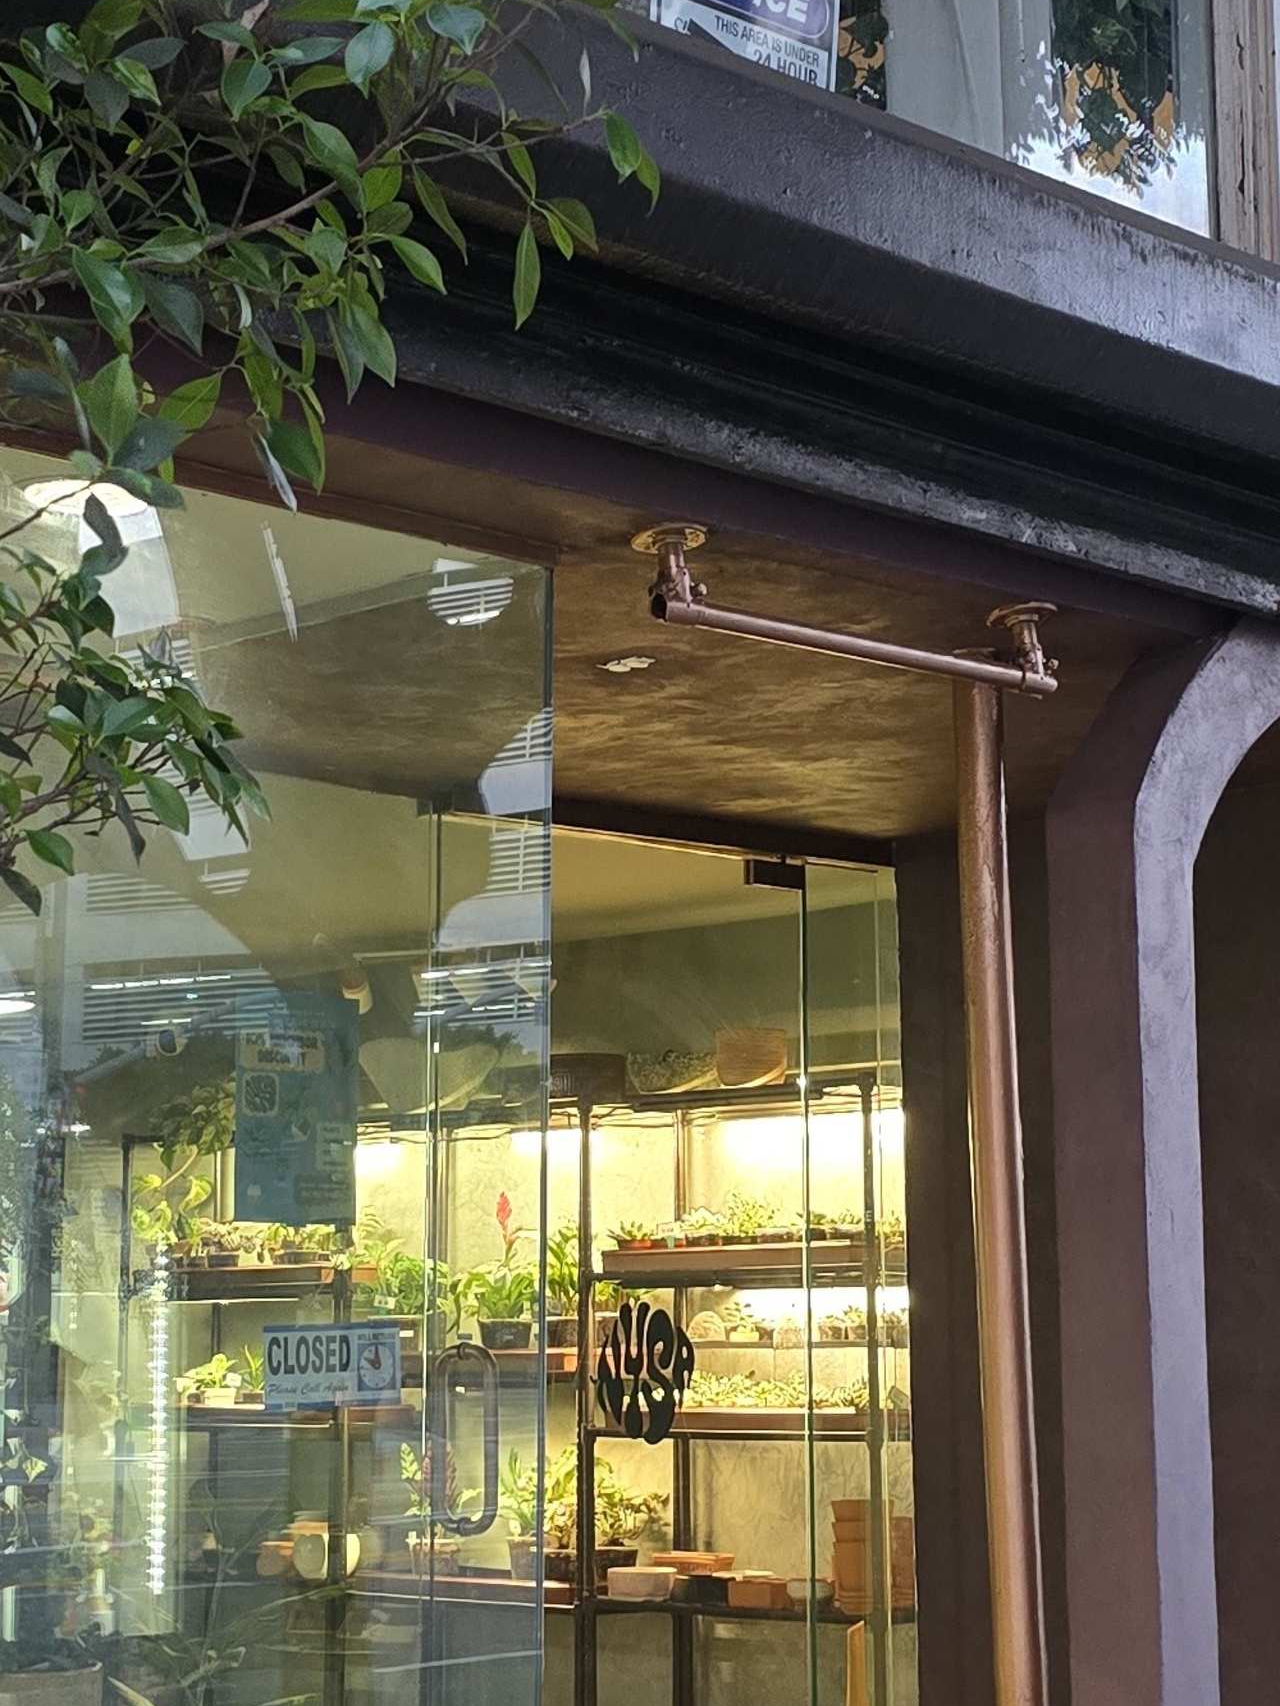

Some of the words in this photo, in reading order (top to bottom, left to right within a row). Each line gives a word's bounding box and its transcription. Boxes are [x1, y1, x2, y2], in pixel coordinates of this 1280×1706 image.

[714, 15, 739, 38] THIS
[740, 25, 769, 49] AREA
[771, 37, 782, 54] IS
[784, 41, 820, 68] UNDER
[267, 1334, 351, 1376] CLOSED
[589, 1301, 695, 1445] NYSA
